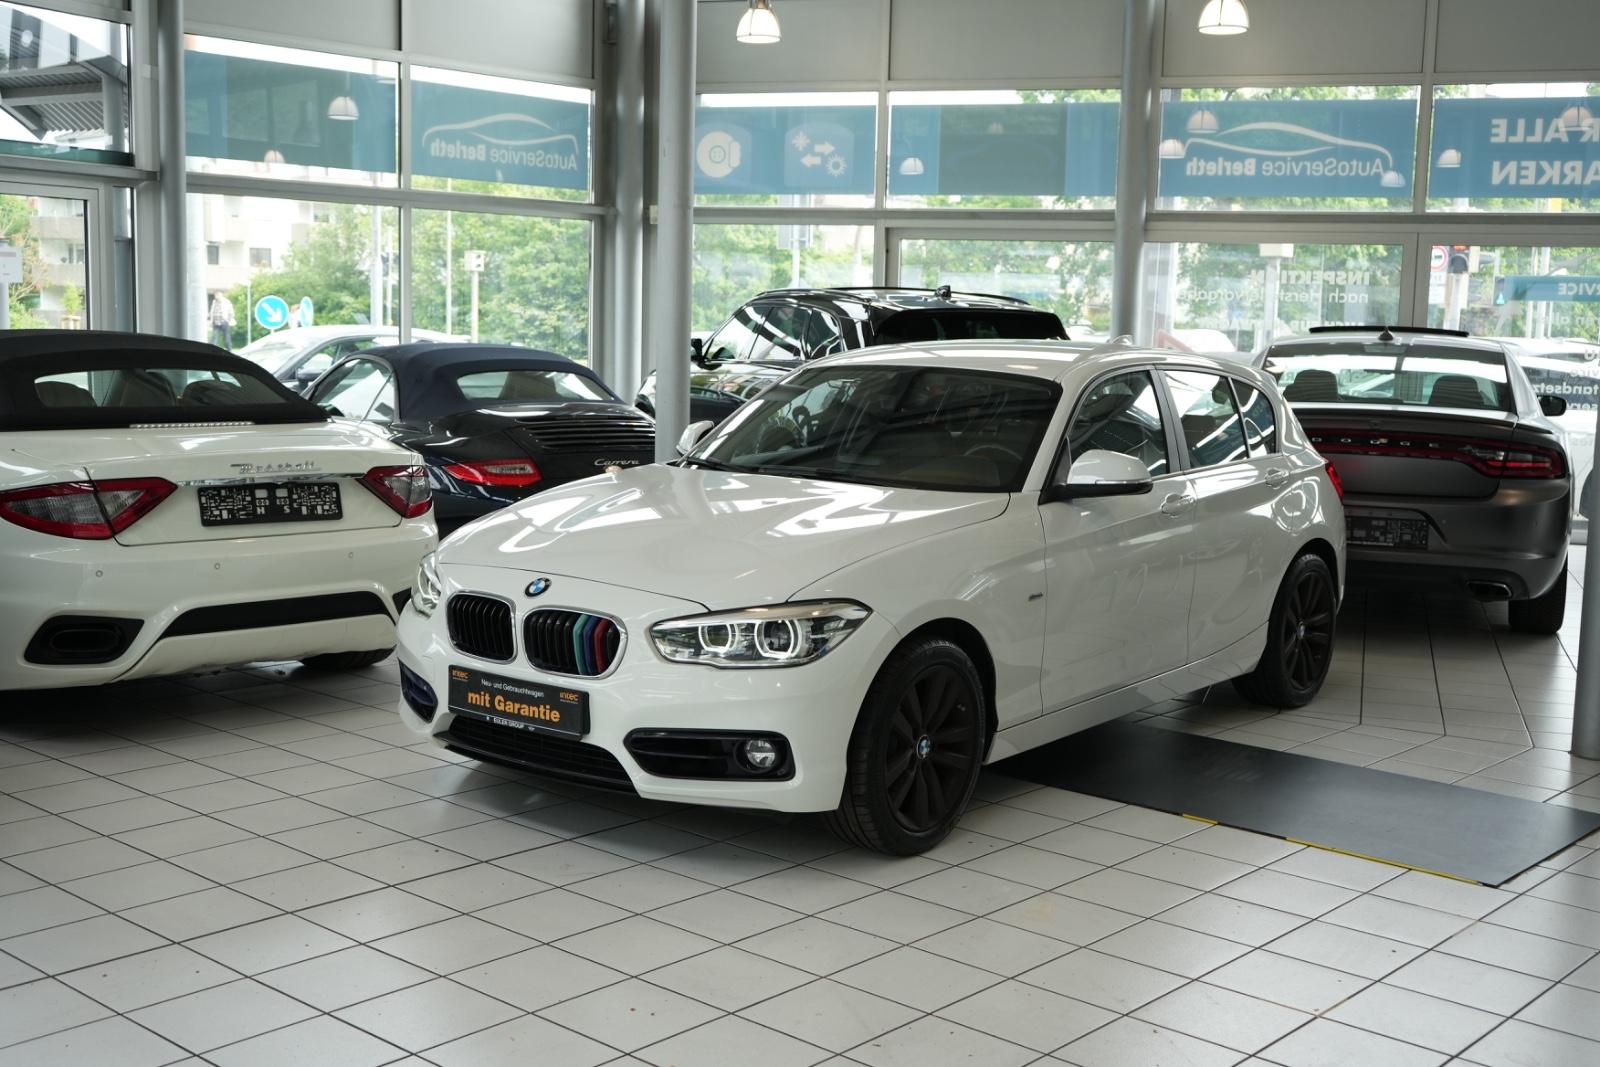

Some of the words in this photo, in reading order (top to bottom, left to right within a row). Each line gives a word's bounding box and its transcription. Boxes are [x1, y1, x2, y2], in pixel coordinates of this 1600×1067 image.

[593, 458, 640, 466] Carrera
[467, 690, 491, 708] mit
[494, 695, 561, 723] Garantie
